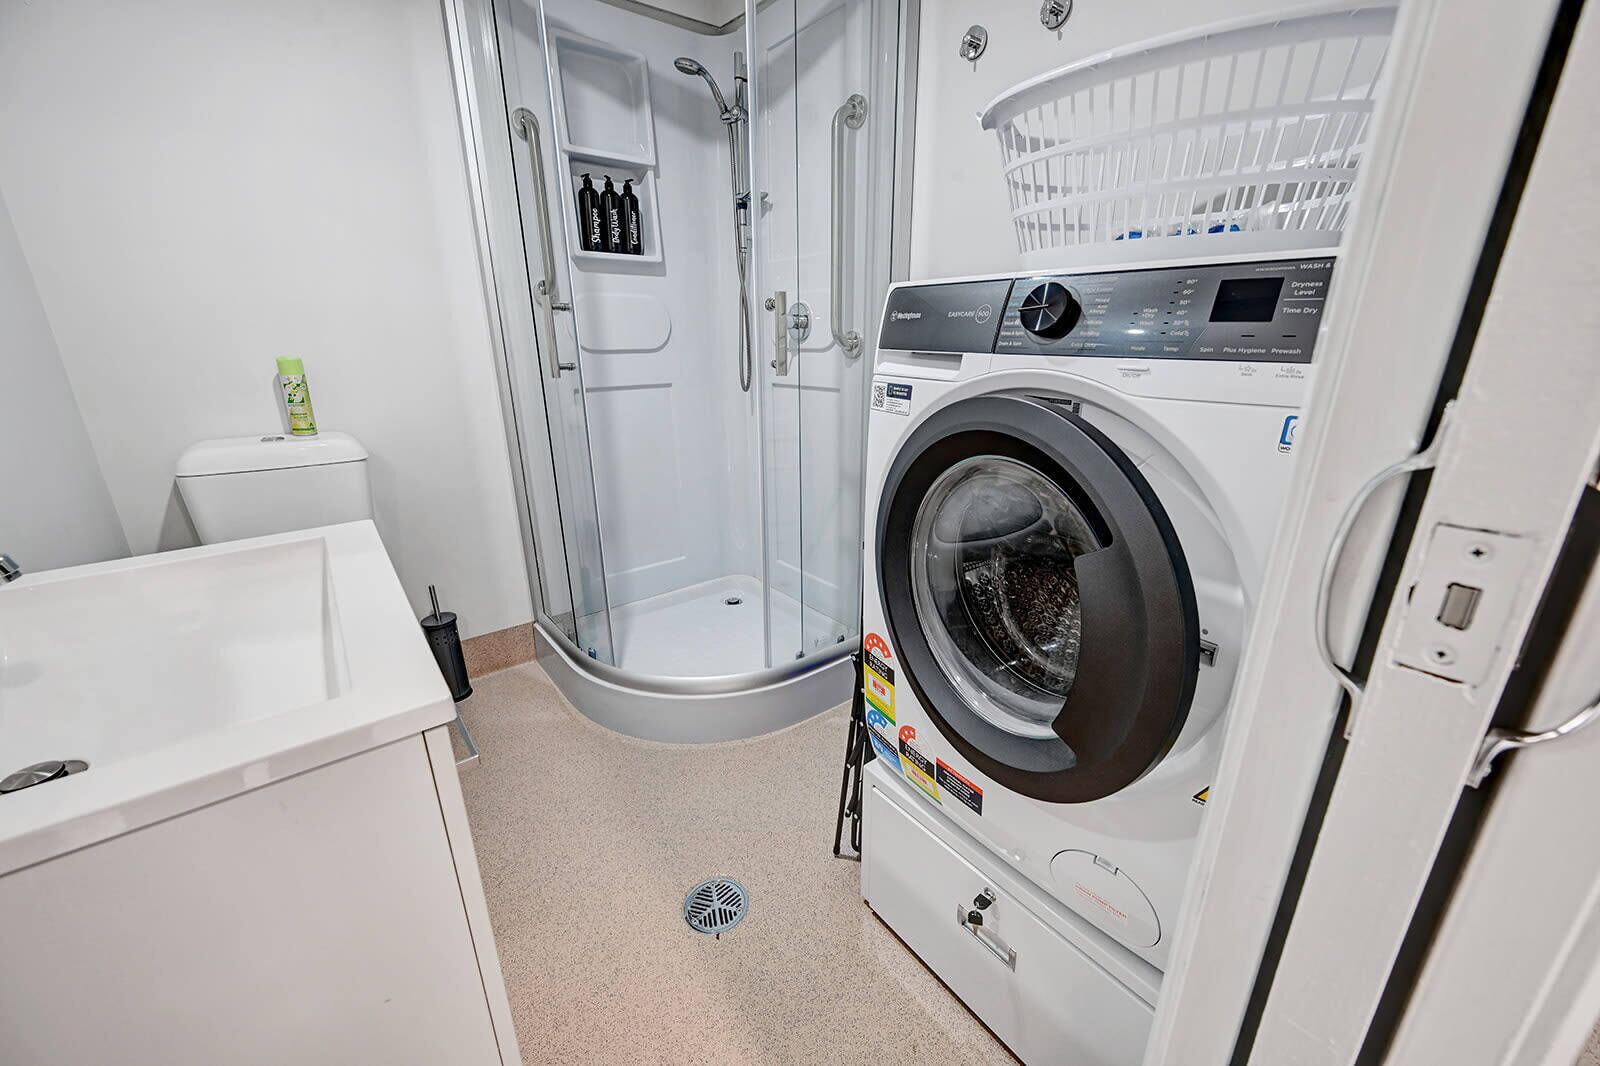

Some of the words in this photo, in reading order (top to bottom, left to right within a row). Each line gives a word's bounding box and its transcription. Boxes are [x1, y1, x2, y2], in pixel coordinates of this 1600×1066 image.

[609, 208, 619, 228] Wash
[591, 207, 601, 244] Shampoo
[630, 210, 639, 245] Conditioner
[611, 227, 621, 244] Body
[1300, 262, 1324, 270] WASH
[1291, 281, 1324, 289] Dryness
[1303, 307, 1318, 315] Dry
[1223, 346, 1237, 354] Plus
[1238, 346, 1266, 355] Hygiene
[1271, 347, 1302, 355] Prewash
